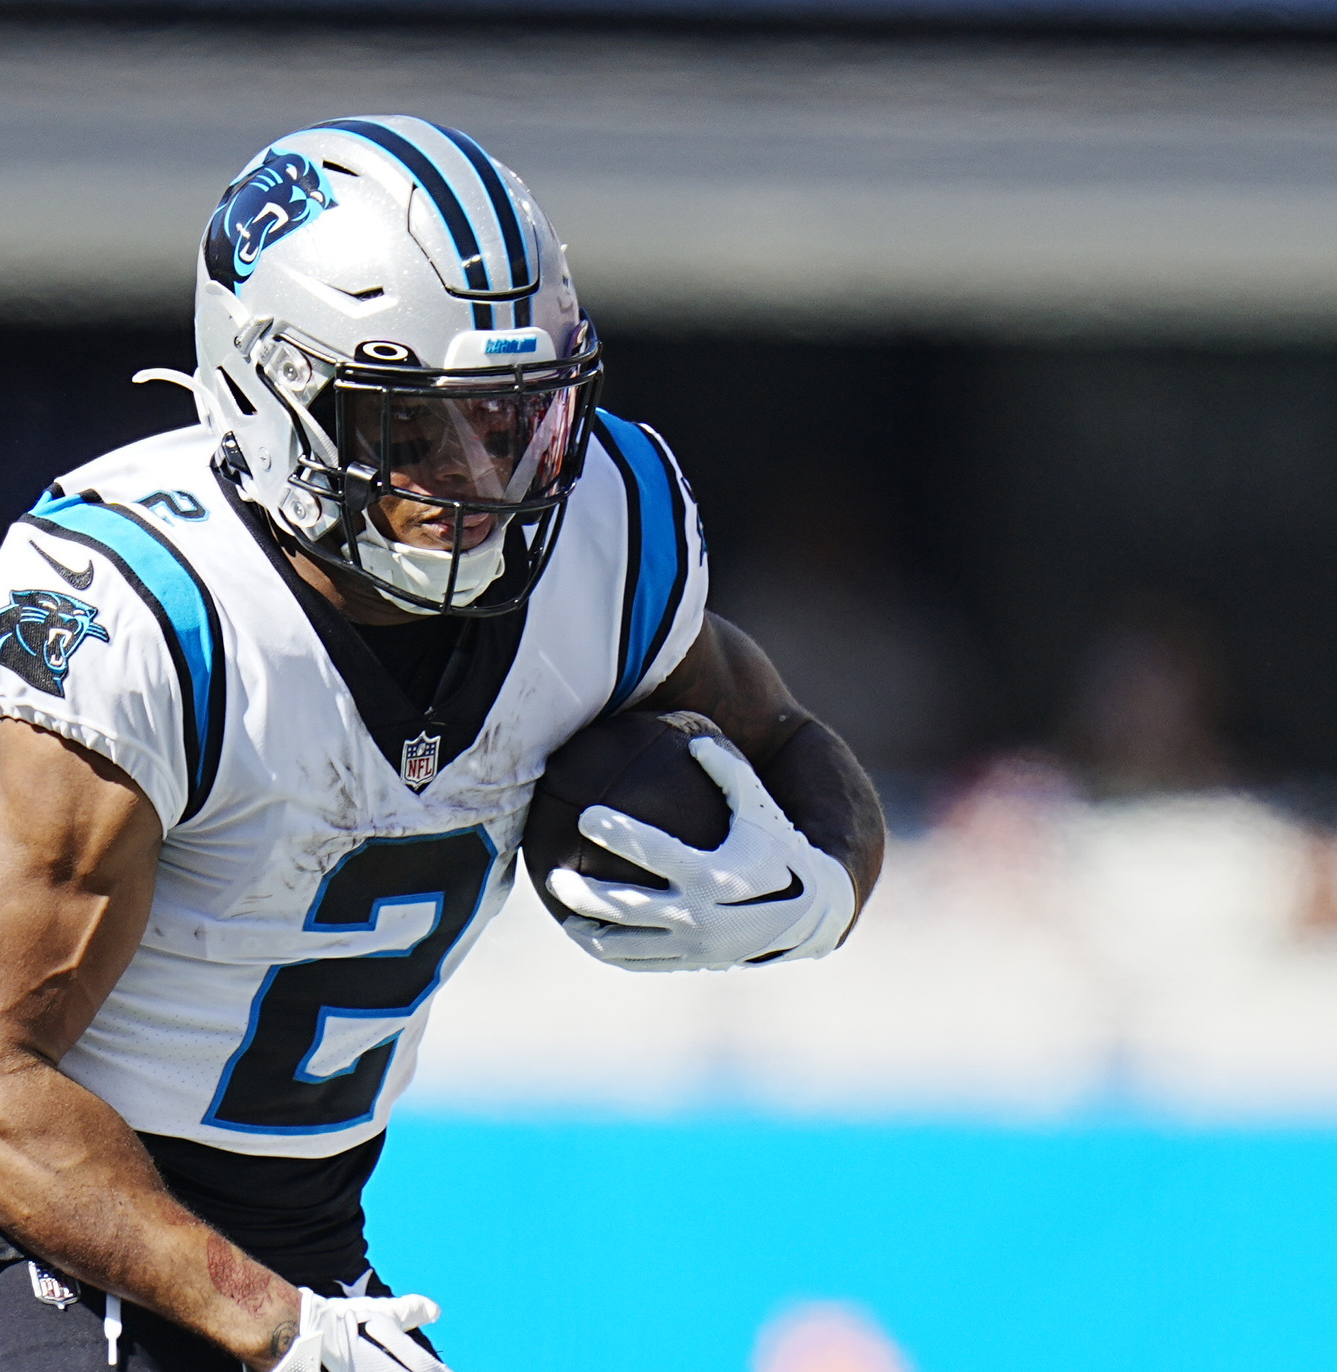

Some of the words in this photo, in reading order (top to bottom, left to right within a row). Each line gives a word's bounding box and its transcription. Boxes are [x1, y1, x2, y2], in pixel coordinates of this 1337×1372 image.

[133, 490, 210, 527] 2
[407, 757, 433, 779] NFL
[200, 824, 498, 1137] 2
